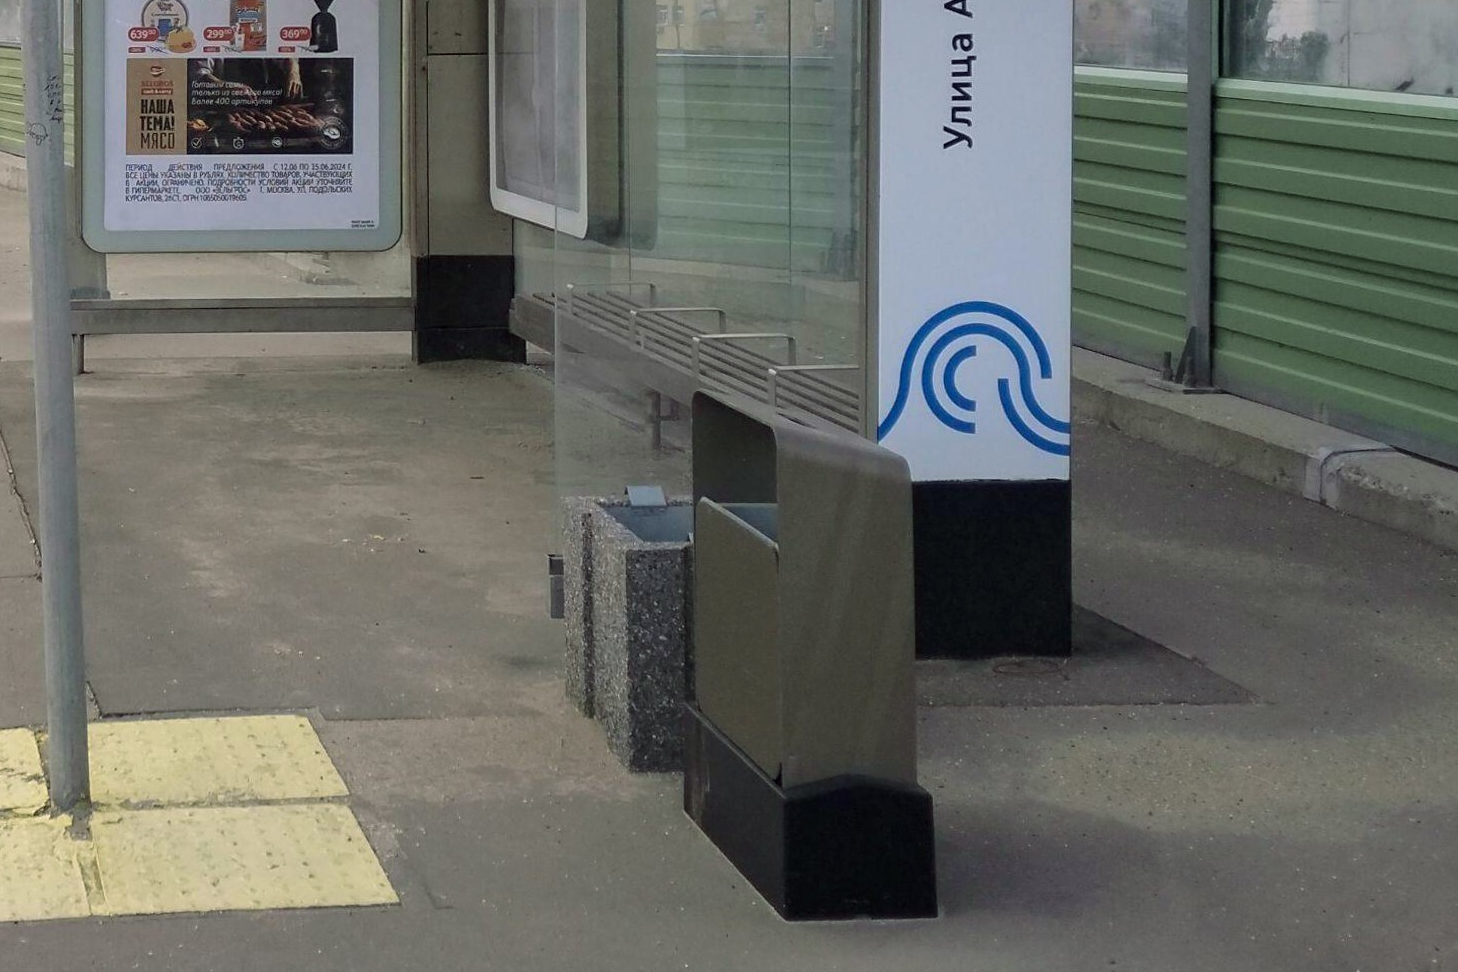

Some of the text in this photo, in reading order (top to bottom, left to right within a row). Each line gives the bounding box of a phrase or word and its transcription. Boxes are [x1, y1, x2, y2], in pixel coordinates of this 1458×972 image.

[943, 34, 978, 150] Улица
[141, 99, 174, 114] НАША
[140, 116, 175, 131] ТЕМА!
[141, 132, 175, 149] МЯСО
[126, 163, 153, 171] ПЕРИОД
[168, 162, 203, 171] ДЕЙСТВИЯ
[214, 163, 265, 171] ПРЕДЛОЖЕНИЯ
[207, 179, 256, 187] ПОДРОБНОСТИ
